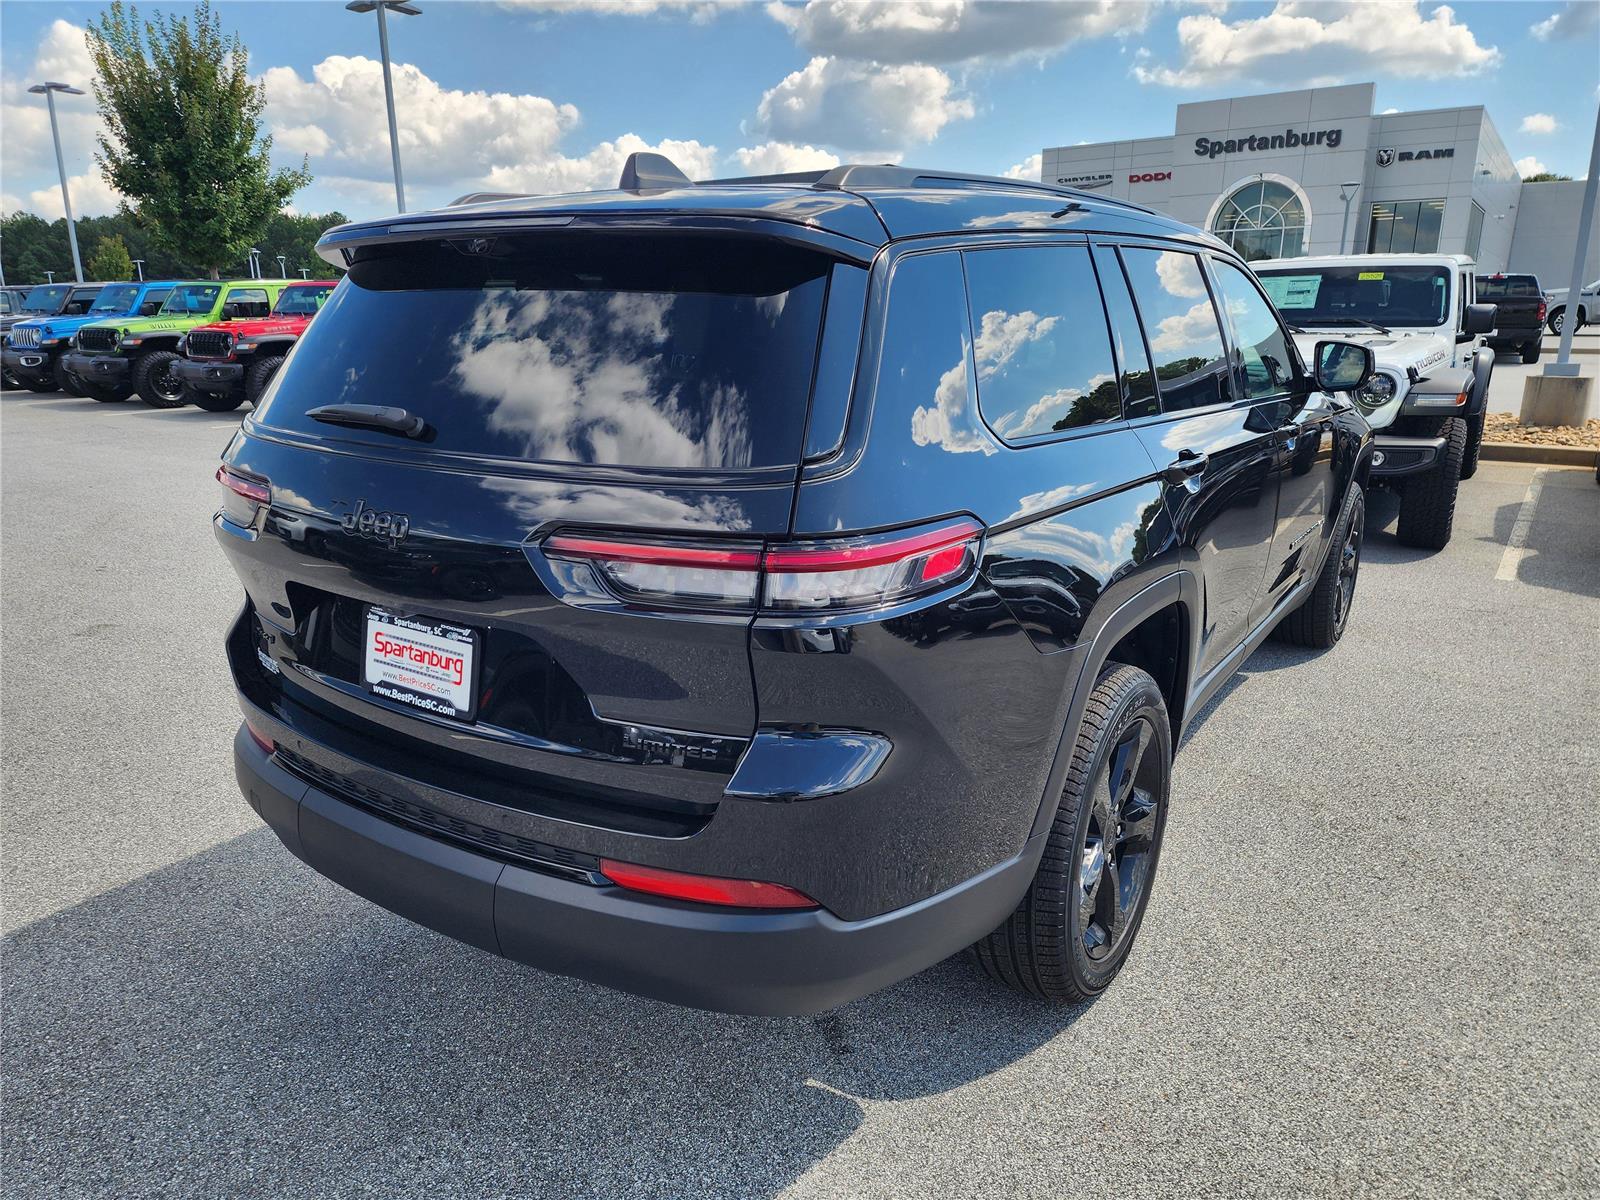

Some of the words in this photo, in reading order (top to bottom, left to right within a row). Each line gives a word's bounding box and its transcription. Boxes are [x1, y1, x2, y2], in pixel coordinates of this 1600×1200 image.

[1195, 129, 1342, 159] Spartanburg
[1398, 148, 1455, 162] RAM
[1057, 174, 1113, 184] CHRYSLER
[1415, 349, 1446, 370] RUBICON
[341, 498, 409, 545] Jeep
[394, 616, 433, 636] Spartanburg,
[434, 626, 443, 636] SC
[374, 631, 464, 687] Spartanburg
[382, 671, 451, 696] www.BestPriceSC.com
[372, 684, 456, 717] www.BestPriceSC.com
[622, 732, 718, 761] LIMITED
